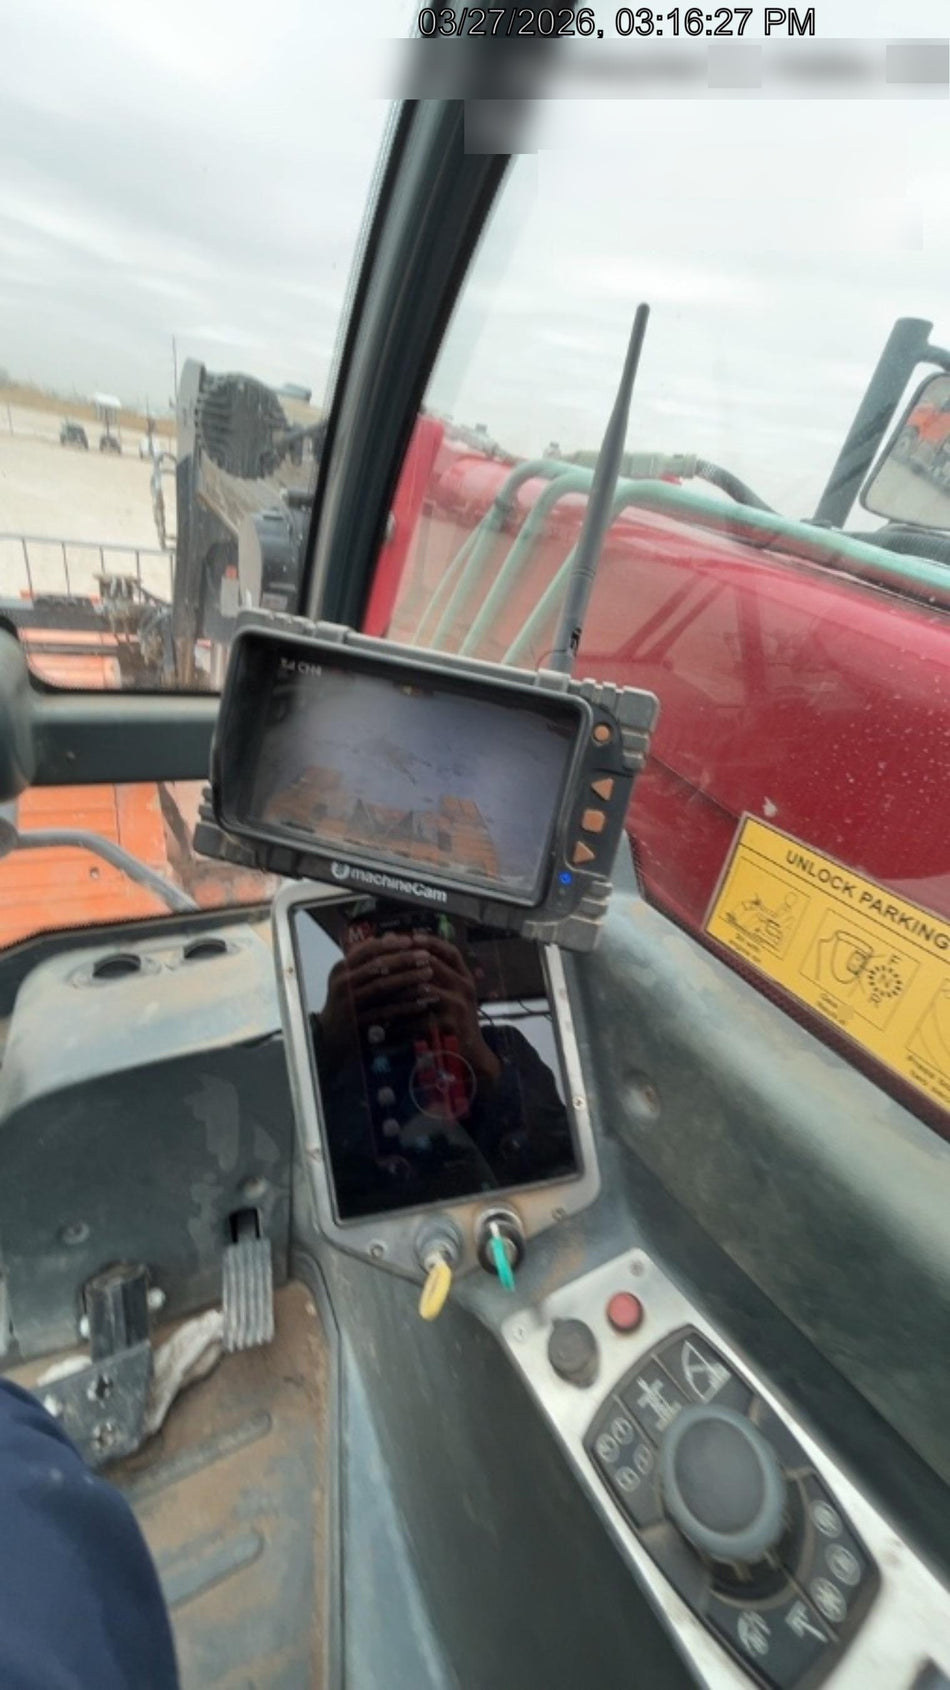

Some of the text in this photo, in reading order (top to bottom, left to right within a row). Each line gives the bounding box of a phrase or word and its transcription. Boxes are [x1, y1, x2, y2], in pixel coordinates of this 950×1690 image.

[349, 867, 448, 903] machineCam
[786, 850, 950, 950] UNLOCK PARKING
